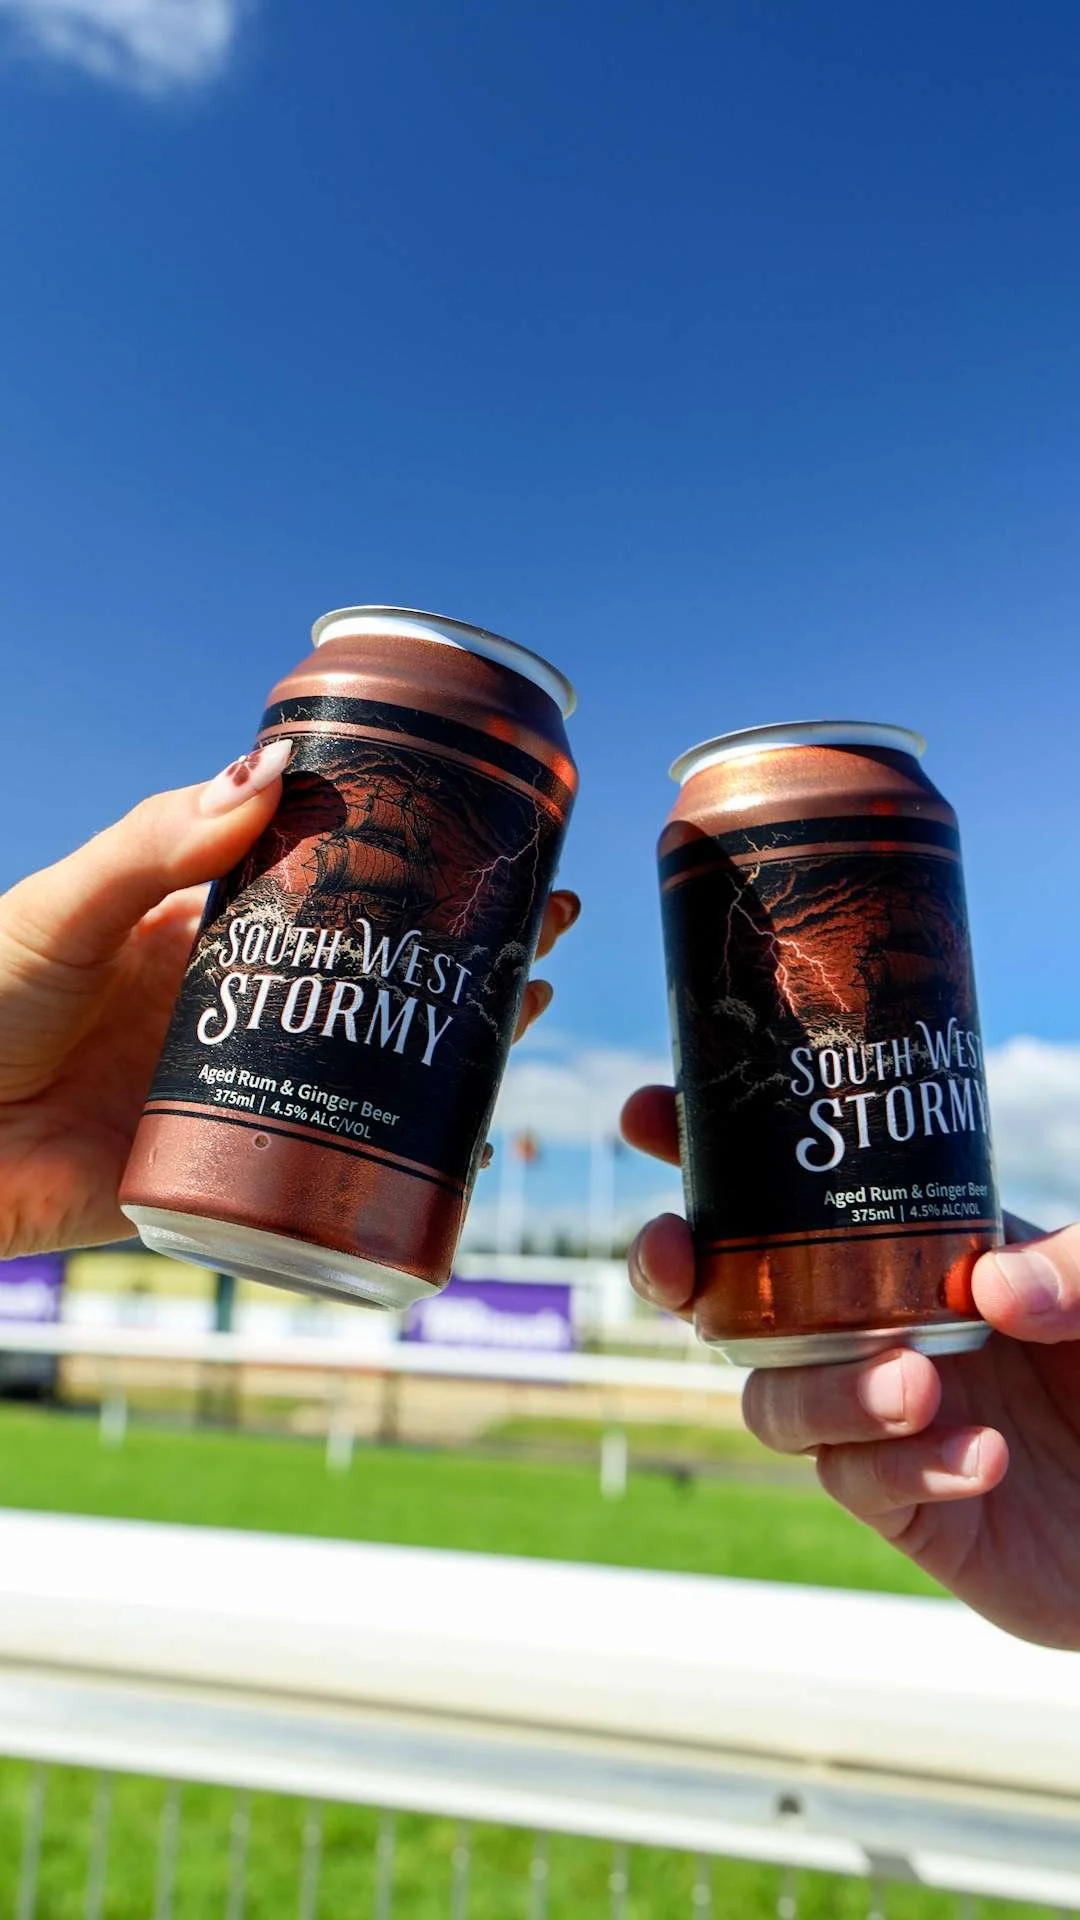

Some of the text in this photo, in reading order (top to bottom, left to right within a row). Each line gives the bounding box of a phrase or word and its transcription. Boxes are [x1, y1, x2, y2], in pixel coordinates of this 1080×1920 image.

[218, 918, 473, 1005] SOUTH WEST
[197, 972, 453, 1067] STORMY
[198, 1064, 401, 1126] Aged Rum & Ginger Beer
[790, 1037, 913, 1097] SOUTH
[213, 1088, 256, 1108] 375ml
[270, 1100, 308, 1121] 4.5%
[309, 1110, 372, 1139] ALC/VOL
[824, 1182, 988, 1208] Aged Rum & Ginger Beer
[851, 1206, 896, 1222] 375ml
[910, 1204, 941, 1218] 4.5%
[941, 1202, 981, 1217] ALC/VOL
